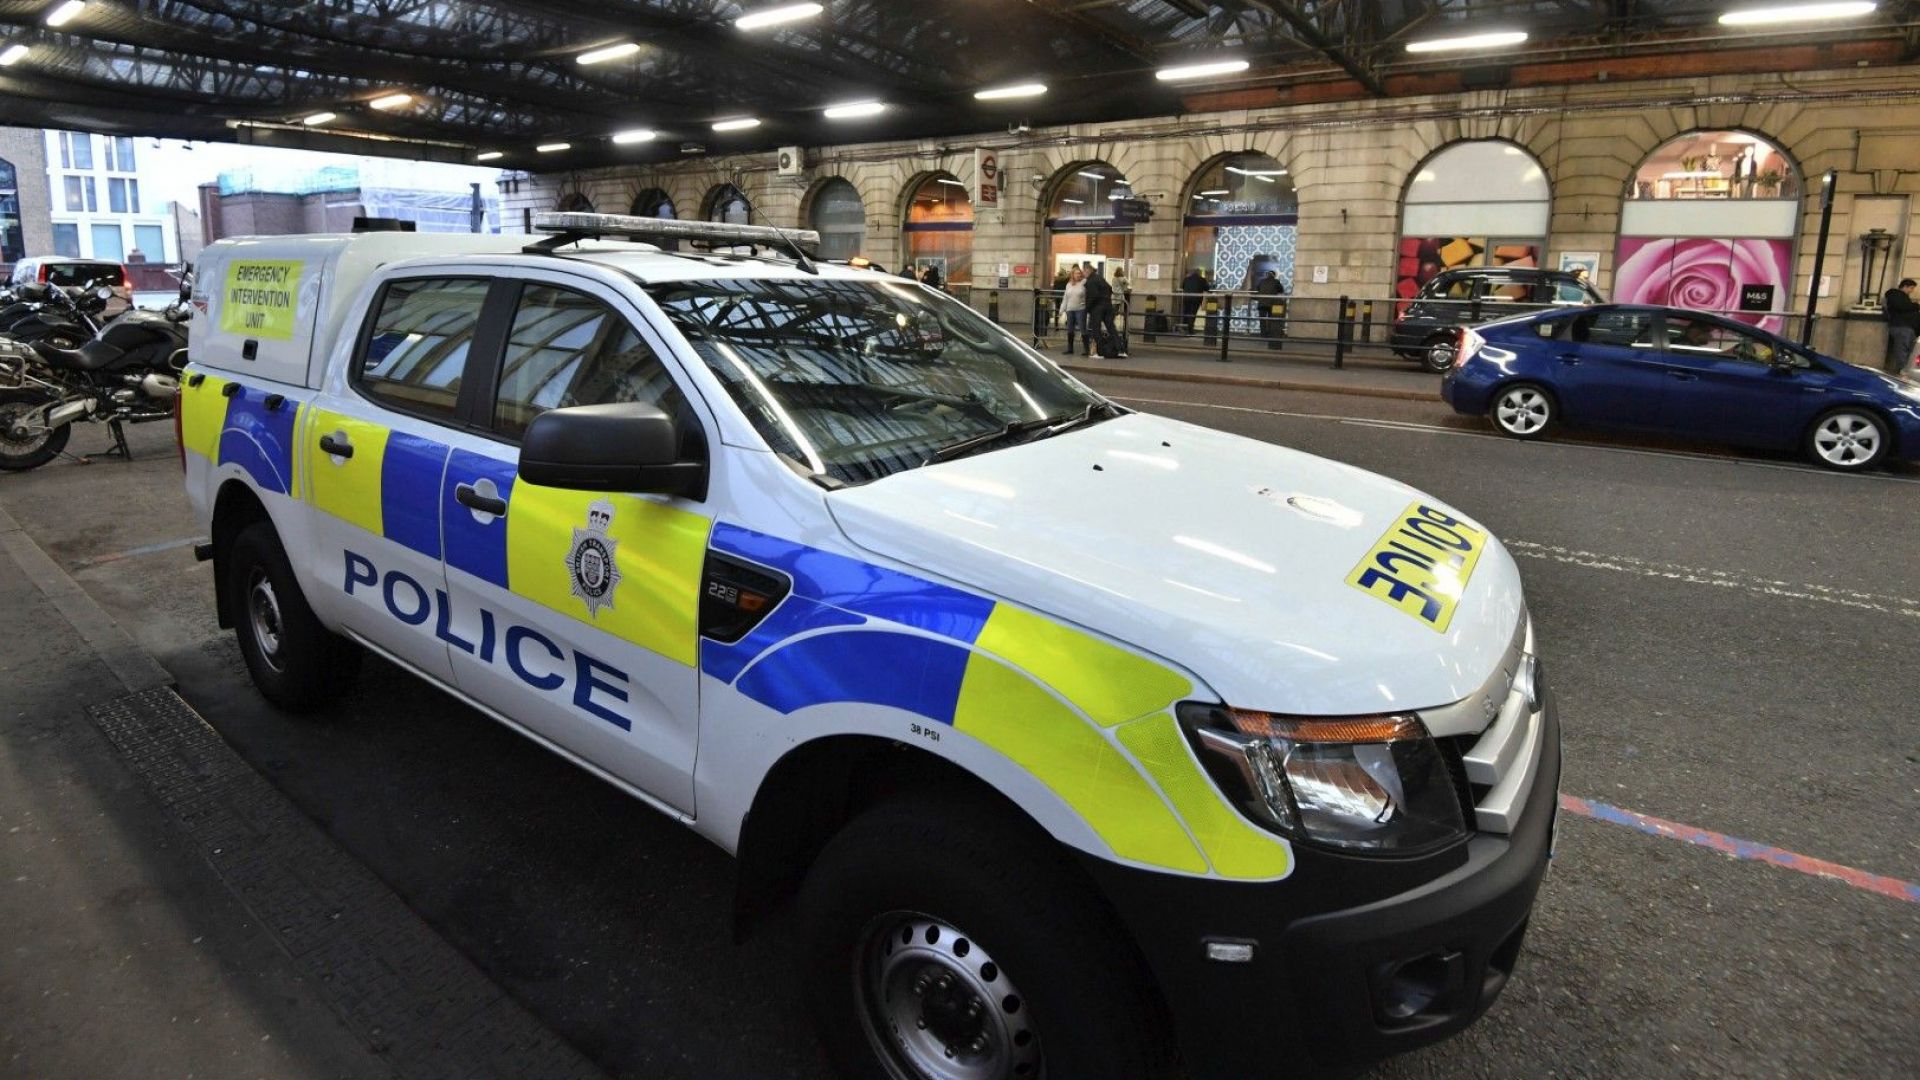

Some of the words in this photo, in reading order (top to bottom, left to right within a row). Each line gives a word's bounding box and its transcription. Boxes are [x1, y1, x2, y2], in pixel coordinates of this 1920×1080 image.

[237, 266, 290, 282] EMERGENCY
[231, 289, 290, 307] INTERVENTION
[1746, 292, 1767, 300] M&S
[246, 313, 265, 328] UNIT
[344, 549, 632, 732] POLICE
[925, 728, 940, 741] PSI
